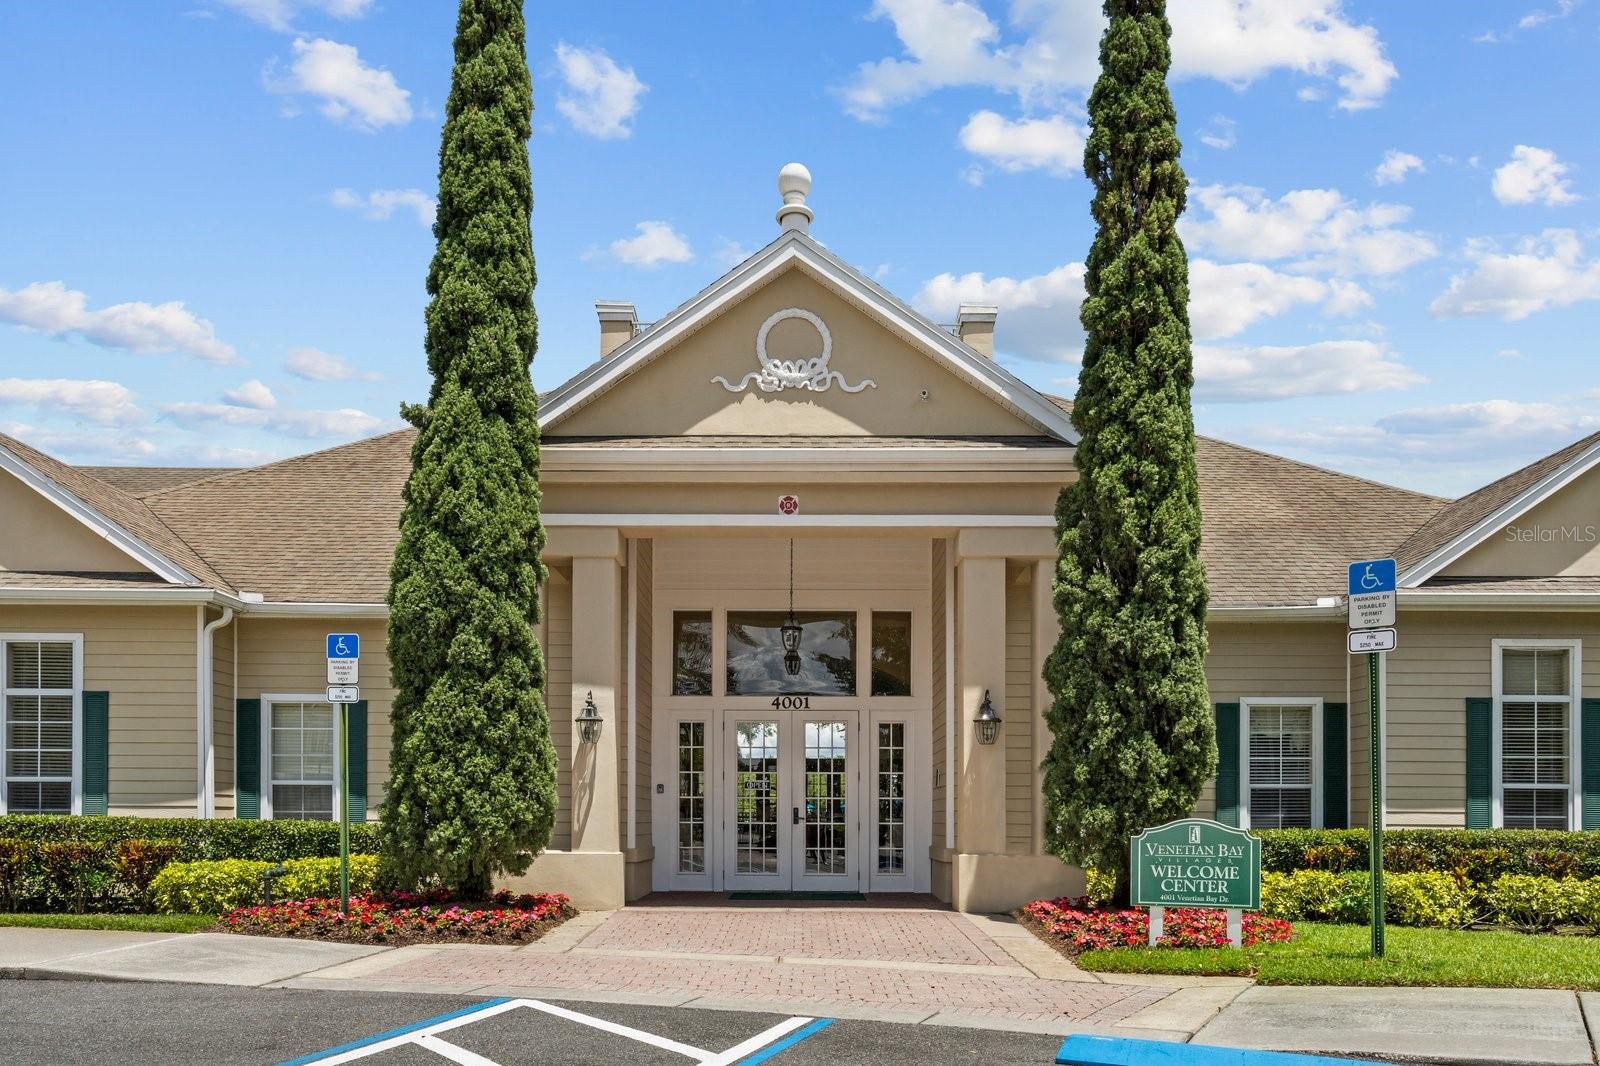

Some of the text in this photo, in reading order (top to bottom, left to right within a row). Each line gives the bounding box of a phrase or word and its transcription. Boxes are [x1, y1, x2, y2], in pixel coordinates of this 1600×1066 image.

[1357, 602, 1387, 610] DISABLED
[771, 696, 810, 710] 4001
[1150, 865, 1240, 880] WELCOME
[1160, 879, 1229, 894] CENTER
